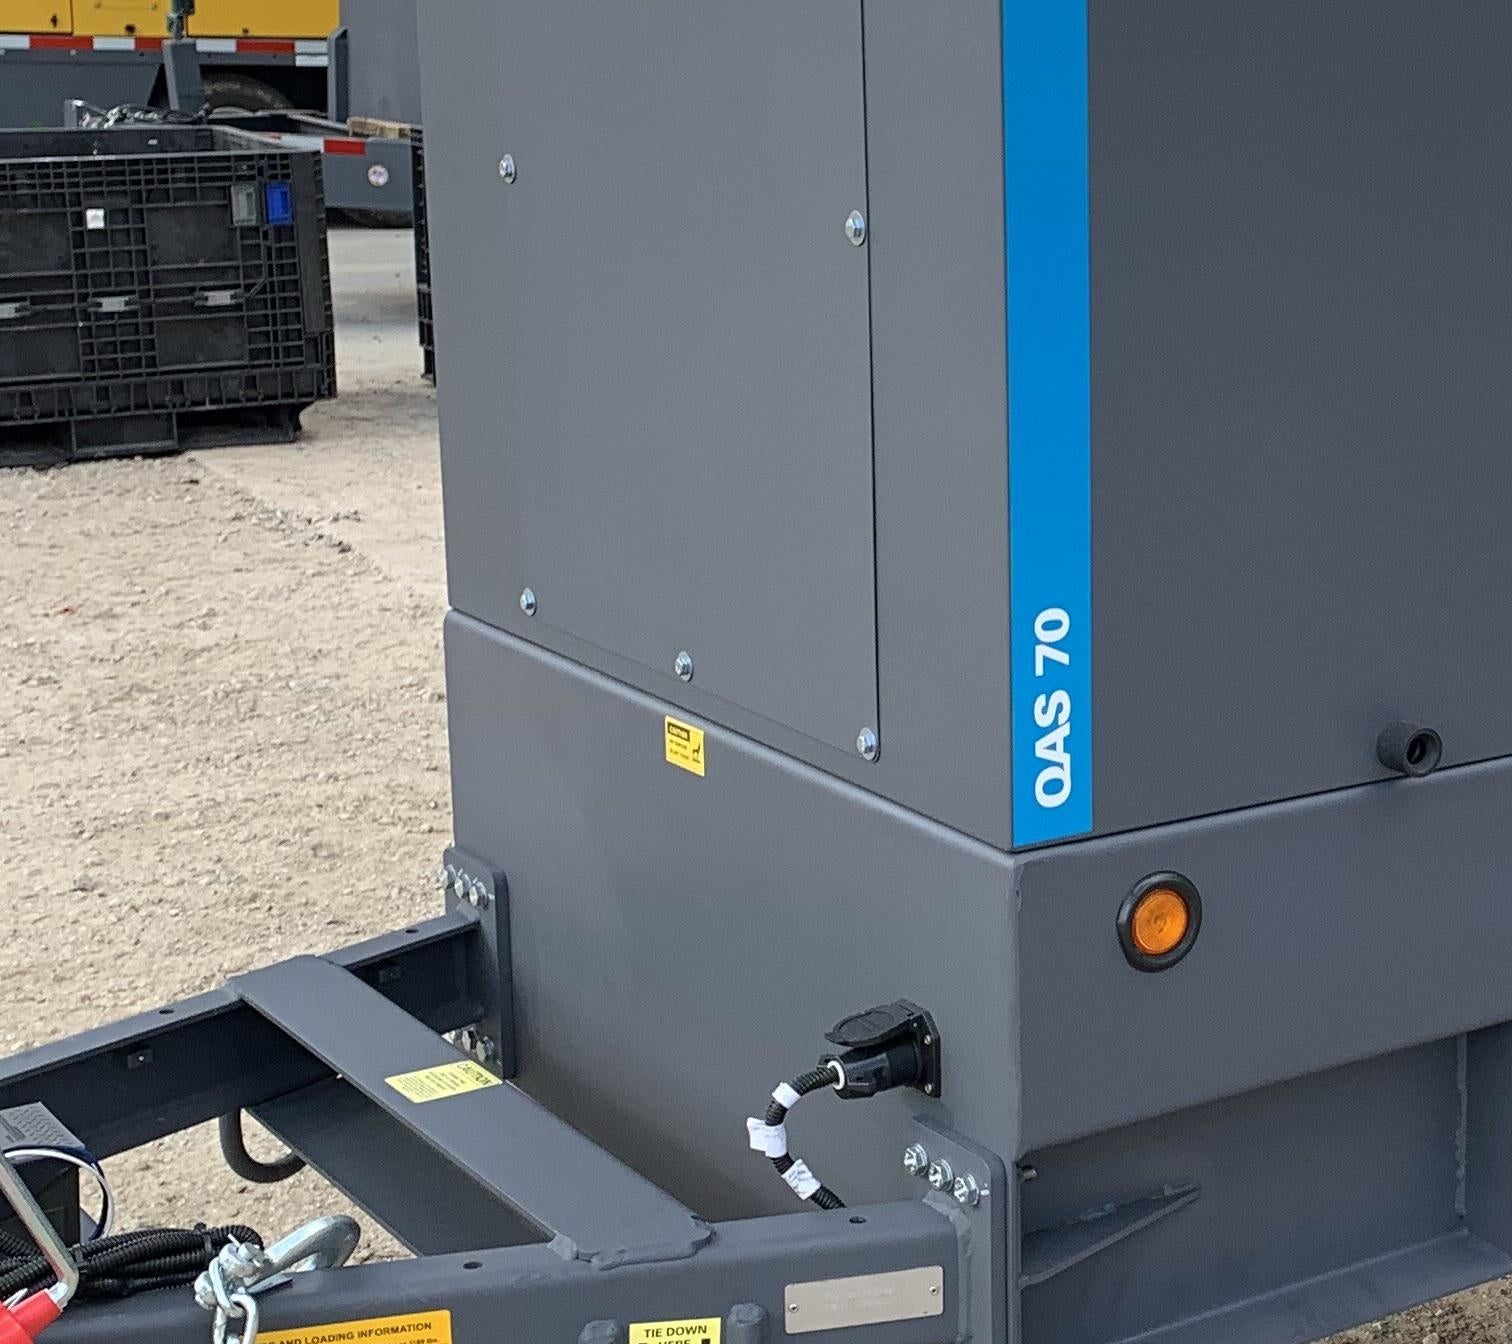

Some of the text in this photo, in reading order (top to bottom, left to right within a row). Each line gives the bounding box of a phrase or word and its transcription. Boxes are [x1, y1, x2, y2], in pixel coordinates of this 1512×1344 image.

[1033, 607, 1071, 808] QAS 70
[357, 1321, 432, 1339] INFORMATION
[644, 1325, 707, 1338] TIE DOWN
